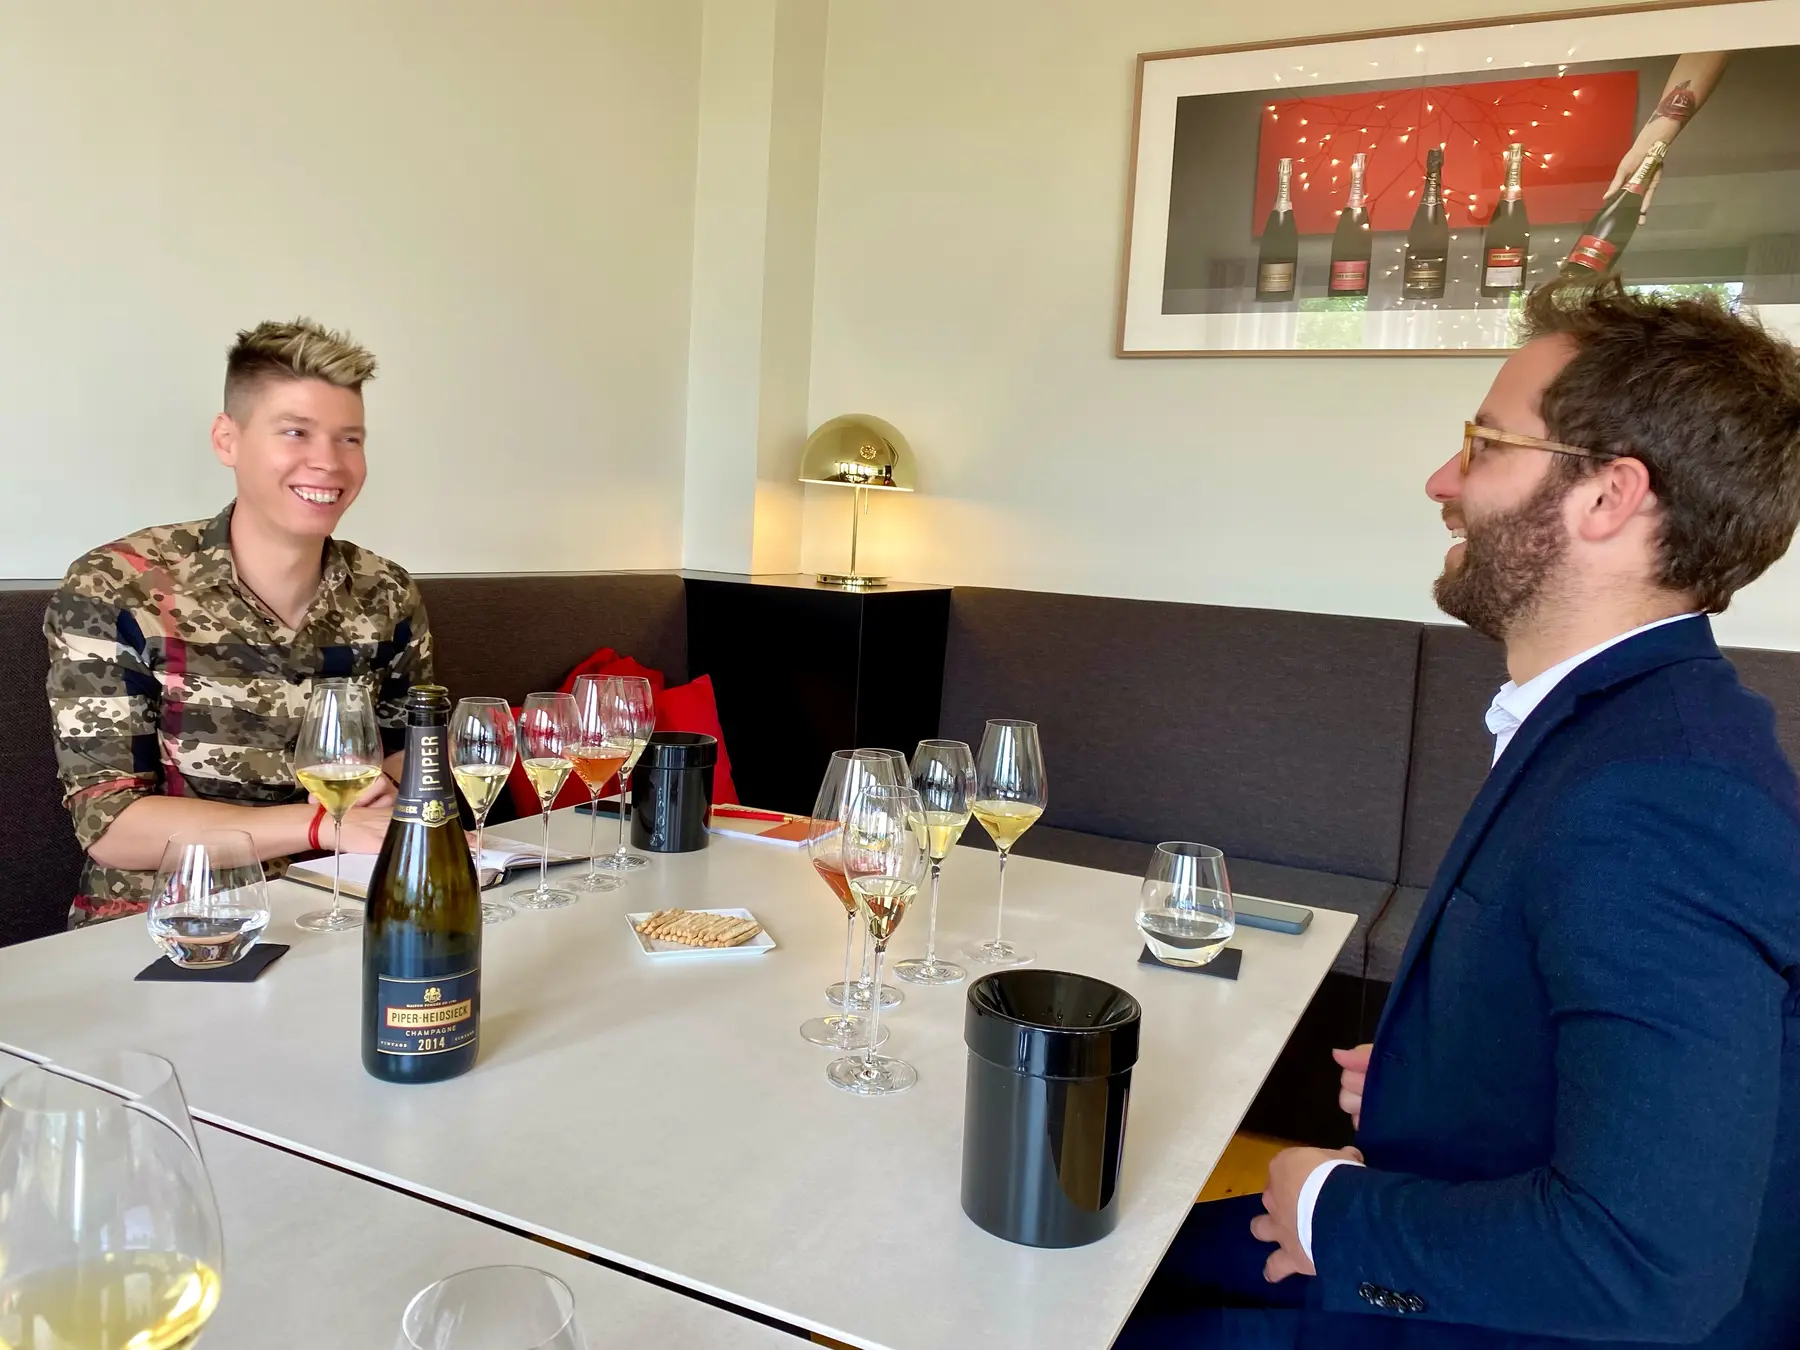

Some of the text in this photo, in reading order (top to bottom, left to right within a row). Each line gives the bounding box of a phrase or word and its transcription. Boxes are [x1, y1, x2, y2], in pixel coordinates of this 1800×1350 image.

[421, 735, 440, 786] PIPER
[391, 1004, 468, 1024] PIPER-HEIDSIECK
[405, 1025, 457, 1037] CHAMPAGNE
[380, 1040, 408, 1048] VINTAGE
[417, 1036, 445, 1051] 2014
